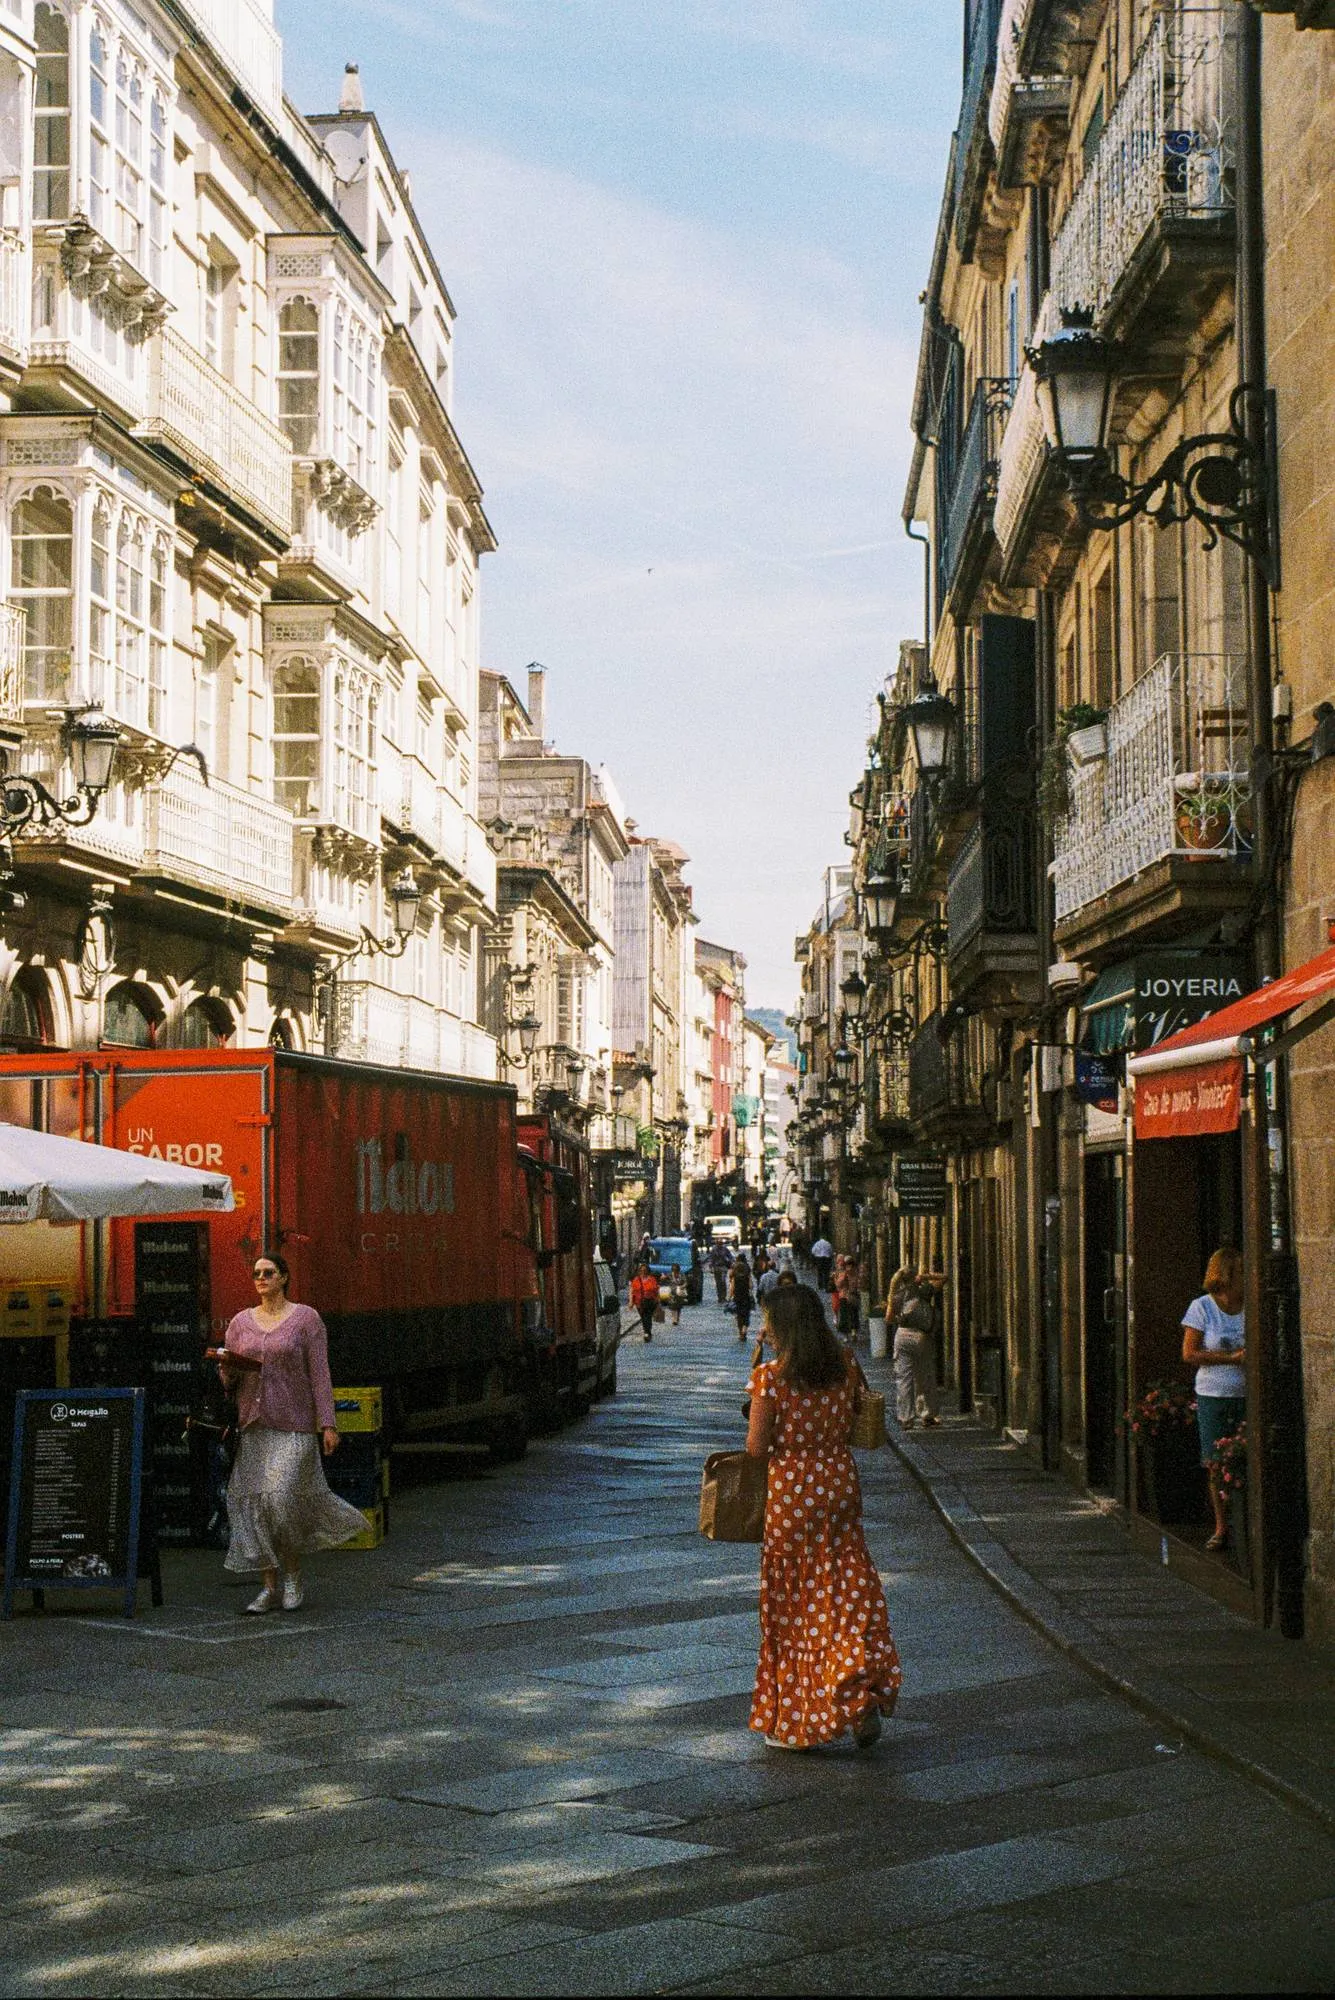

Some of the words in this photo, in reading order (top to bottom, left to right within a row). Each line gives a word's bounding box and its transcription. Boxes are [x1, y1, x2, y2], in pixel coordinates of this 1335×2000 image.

[1140, 978, 1242, 997] JOYERIA
[127, 1127, 153, 1143] UN
[69, 1408, 76, 1417] O
